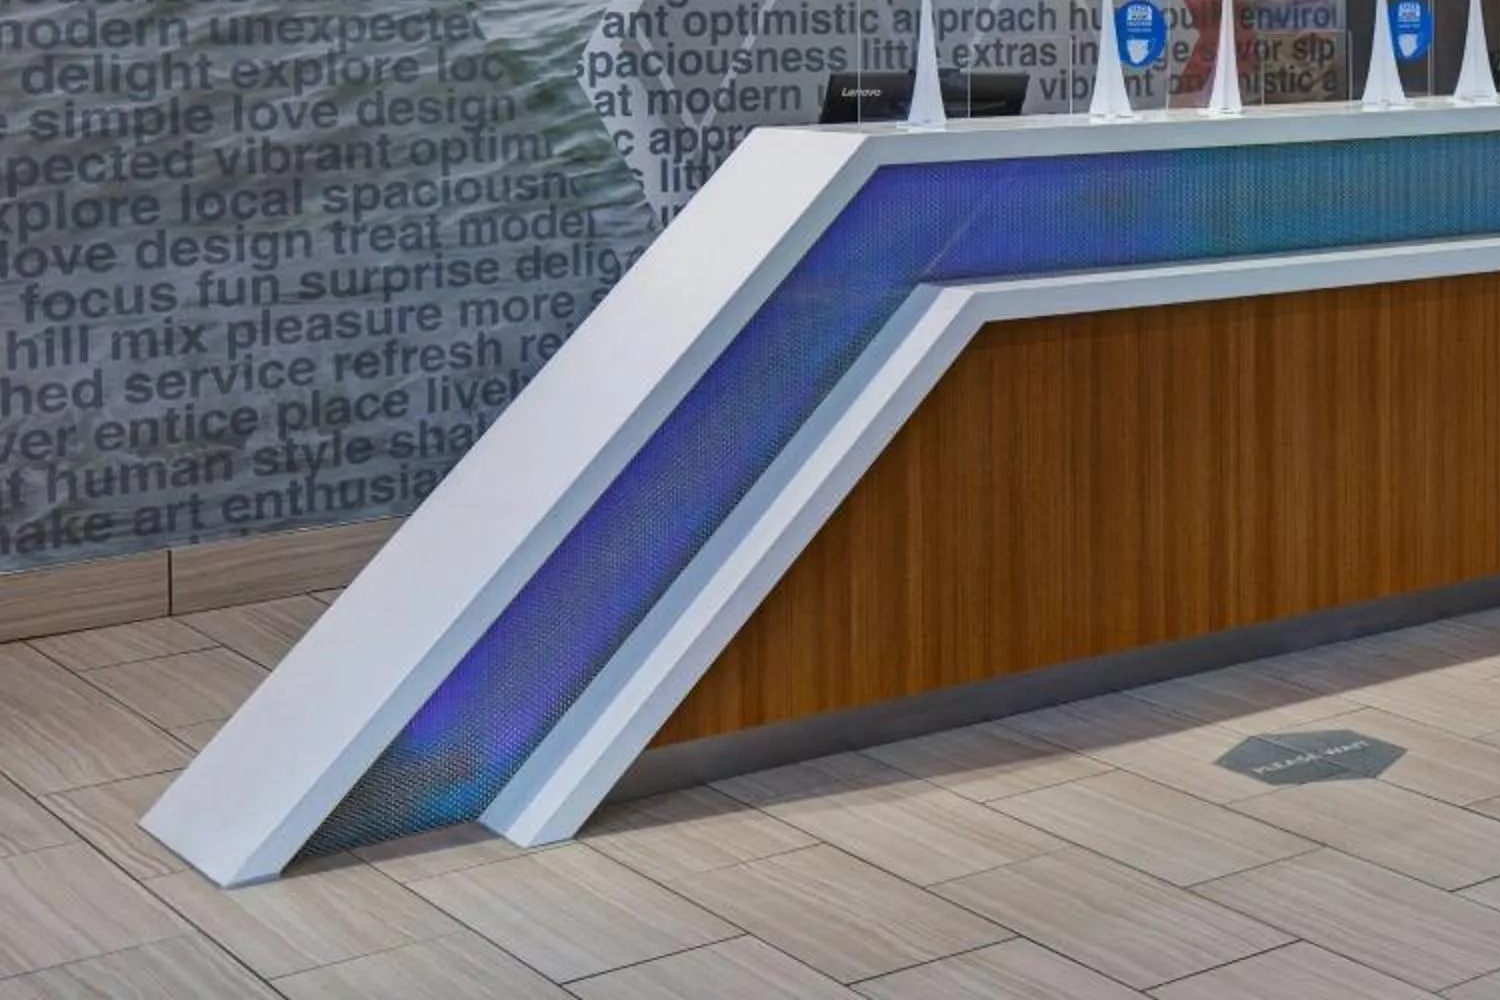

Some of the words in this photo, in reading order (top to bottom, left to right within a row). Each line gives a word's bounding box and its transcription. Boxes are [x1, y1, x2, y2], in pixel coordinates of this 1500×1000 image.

[682, 1, 880, 45] optimistic
[892, 1, 1057, 41] aproach
[1241, 2, 1337, 30] enviro
[22, 53, 214, 100] delight
[231, 48, 420, 95] explore
[863, 37, 941, 71] littl
[952, 41, 1057, 69] extras
[1292, 32, 1335, 67] sip
[29, 98, 214, 145] simple
[234, 95, 339, 132] love
[356, 90, 515, 133] design
[648, 79, 800, 117] modern
[214, 133, 392, 178] vibrant
[182, 179, 302, 223] local
[0, 240, 116, 281] love
[136, 225, 312, 271] design
[332, 214, 442, 255] treat
[20, 280, 178, 325] focus
[196, 269, 281, 309] fun
[300, 253, 500, 303] surprise
[111, 317, 208, 361] mix
[228, 302, 443, 361] pleasure
[460, 290, 575, 328] more
[125, 354, 316, 406] service
[333, 331, 500, 383] refresh
[94, 403, 259, 452] entice
[277, 387, 411, 441] place
[48, 450, 233, 504] human
[253, 431, 374, 487] style
[132, 493, 201, 537] art
